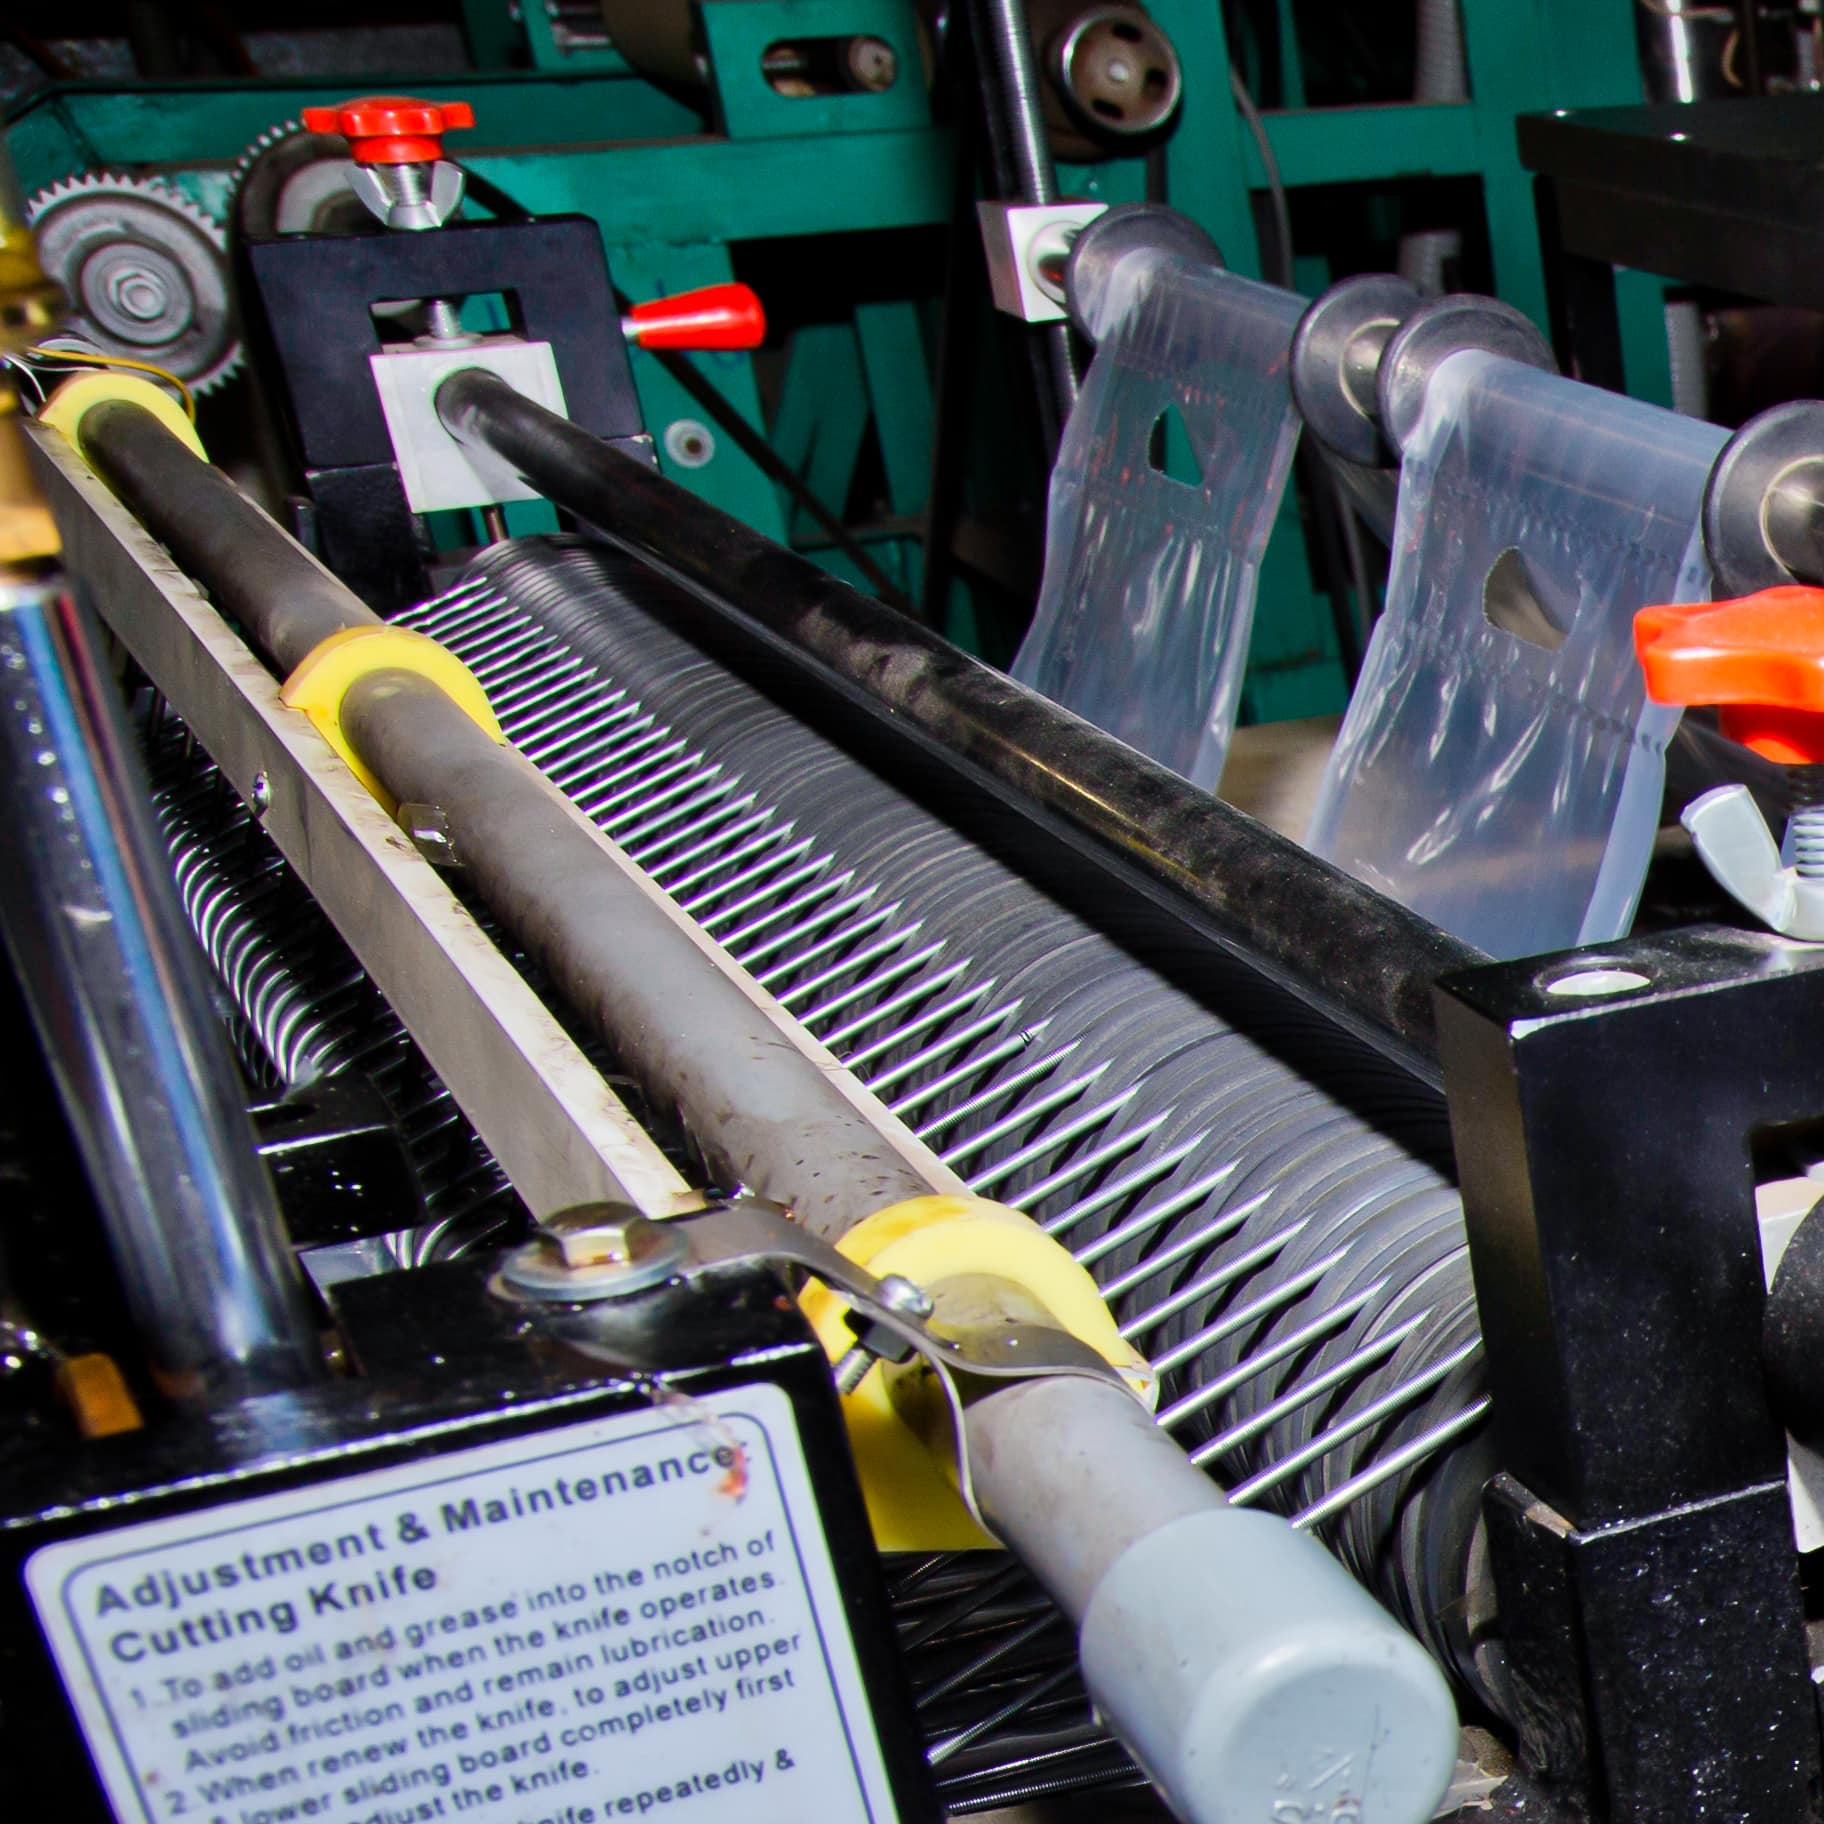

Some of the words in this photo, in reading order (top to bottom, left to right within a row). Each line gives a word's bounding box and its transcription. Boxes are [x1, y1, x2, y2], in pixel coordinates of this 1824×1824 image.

[96, 1523, 386, 1618] Adjustment
[396, 1511, 431, 1545] &
[109, 1600, 299, 1663] Cutting
[307, 1564, 438, 1616] Knife
[160, 1677, 204, 1702] To
[212, 1656, 277, 1691] add
[283, 1643, 326, 1672] oil
[334, 1626, 398, 1661] and
[404, 1599, 518, 1649] grease
[526, 1583, 586, 1611] into
[593, 1568, 644, 1595] the
[652, 1542, 738, 1579] notch
[746, 1529, 774, 1556] of
[171, 1695, 286, 1739] sliding
[289, 1663, 390, 1708] board
[396, 1645, 486, 1680] when
[492, 1629, 545, 1656] the
[552, 1606, 630, 1640] knife
[185, 1729, 281, 1772] Avoid
[285, 1702, 404, 1745] friction
[413, 1680, 474, 1714] and
[482, 1653, 594, 1695] remain
[197, 1765, 300, 1804] When
[306, 1737, 407, 1777] renew
[415, 1721, 468, 1748] the
[572, 1686, 605, 1707] to
[613, 1656, 708, 1698] adjust
[714, 1633, 800, 1671] upper
[341, 1762, 452, 1805] sliding
[456, 1731, 552, 1774] board
[559, 1688, 727, 1747] completely
[734, 1668, 794, 1699] first
[603, 1760, 764, 1817] repeatedly
[774, 1747, 795, 1771] &
[451, 1783, 503, 1811] the
